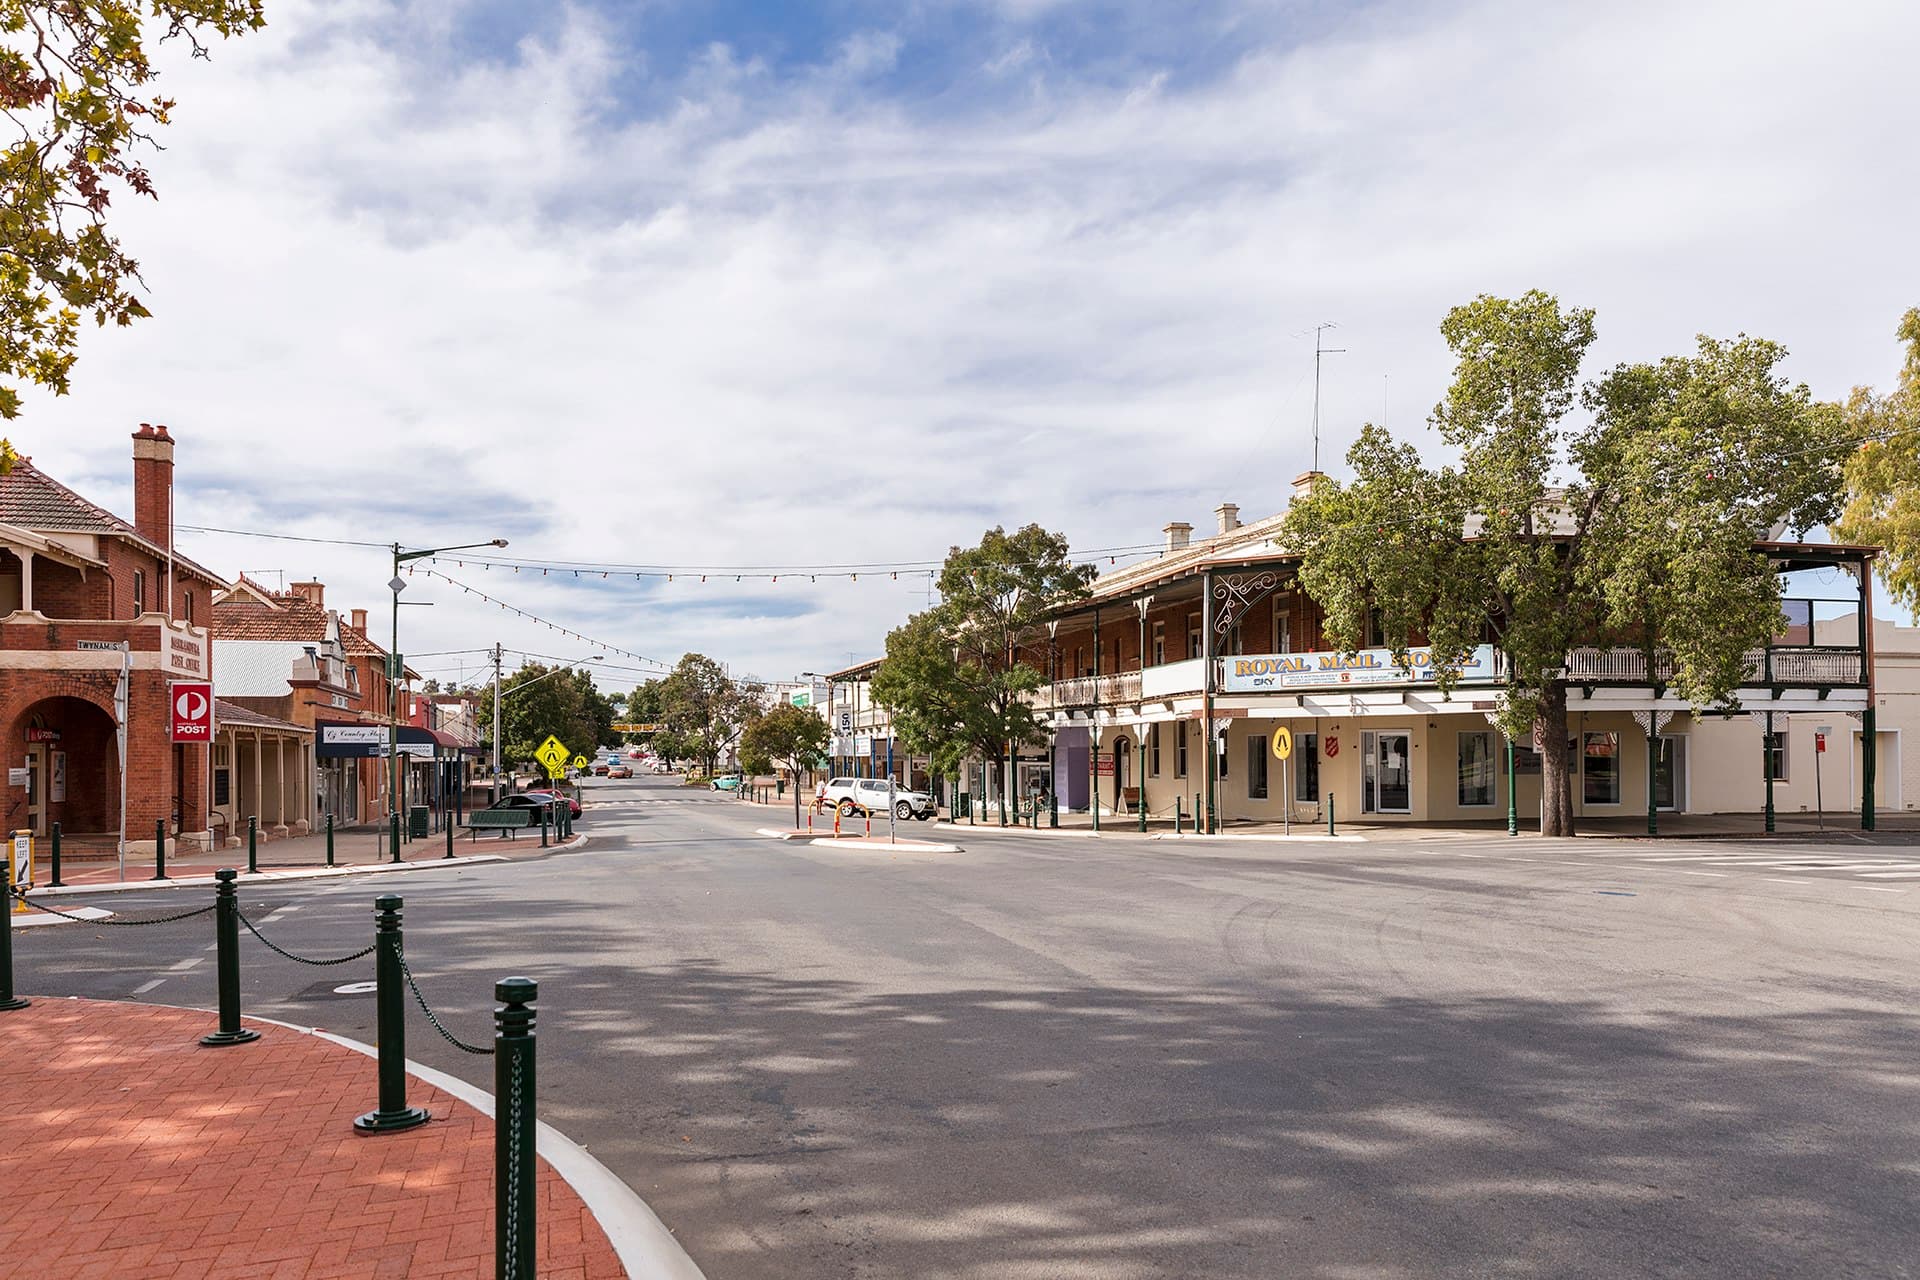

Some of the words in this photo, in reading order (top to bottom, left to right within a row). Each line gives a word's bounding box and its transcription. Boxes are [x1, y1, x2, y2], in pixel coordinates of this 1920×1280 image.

[78, 641, 110, 650] TWYNAM
[1235, 657, 1312, 677] ROYAL
[1319, 653, 1382, 671] MAIL
[1253, 676, 1275, 686] SKY
[841, 713, 850, 731] 150
[177, 725, 207, 734] POST
